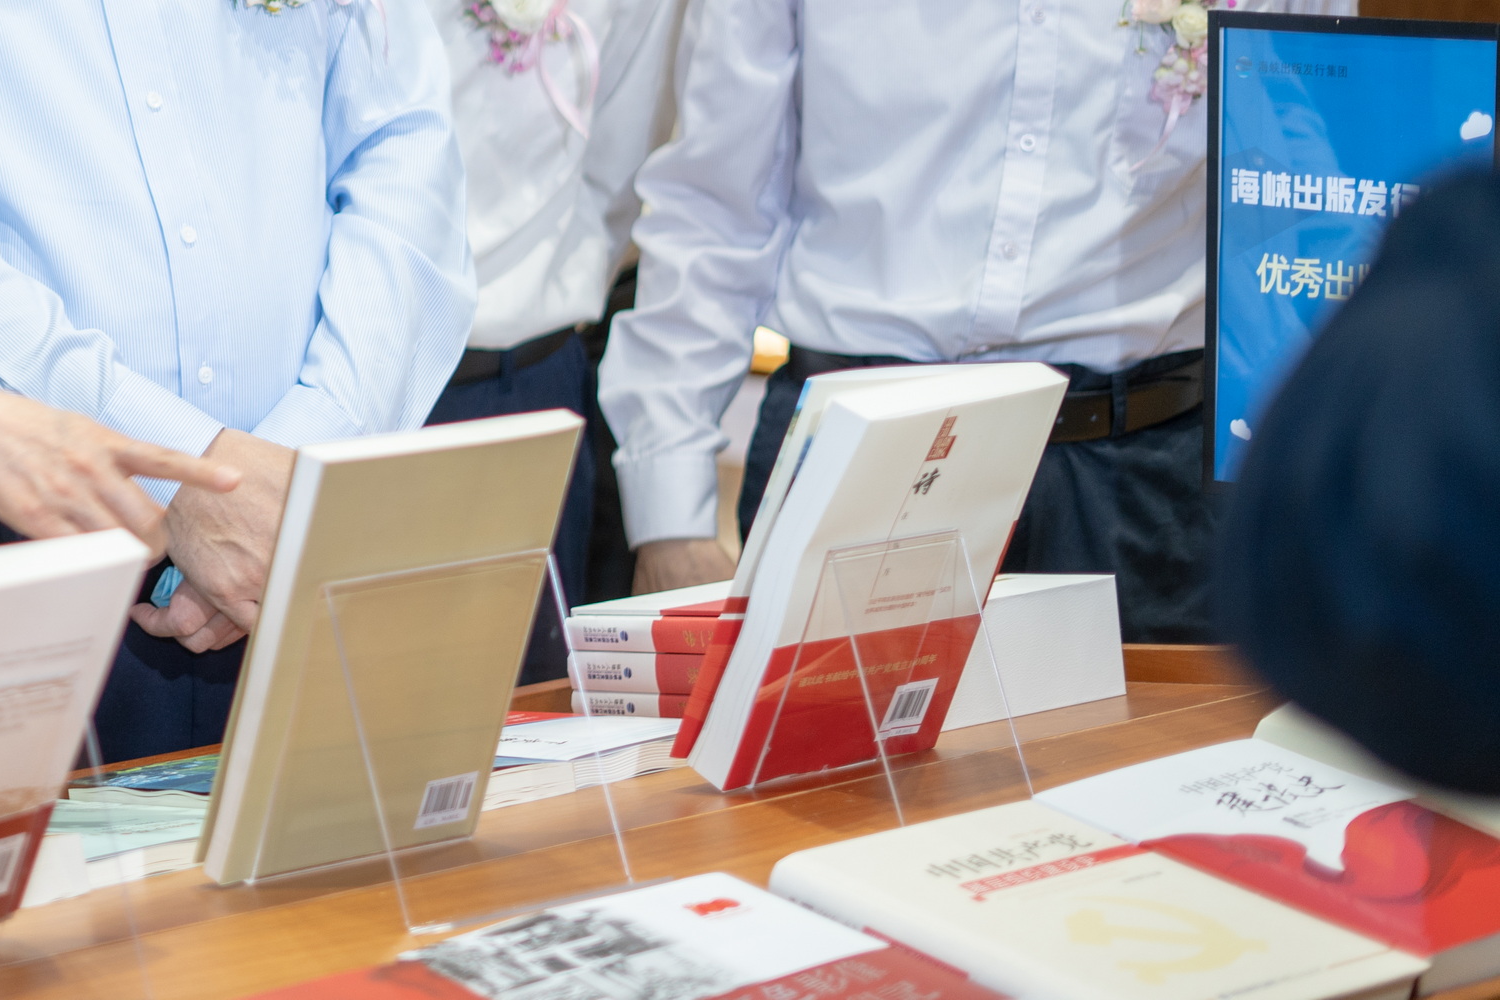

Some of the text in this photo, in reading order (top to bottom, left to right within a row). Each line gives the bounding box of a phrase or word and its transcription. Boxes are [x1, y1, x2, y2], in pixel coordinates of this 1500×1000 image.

[1257, 61, 1348, 78] 海峡出版发行集团
[1256, 252, 1370, 299] 优秀出
[925, 832, 1094, 879] 中国共产党
